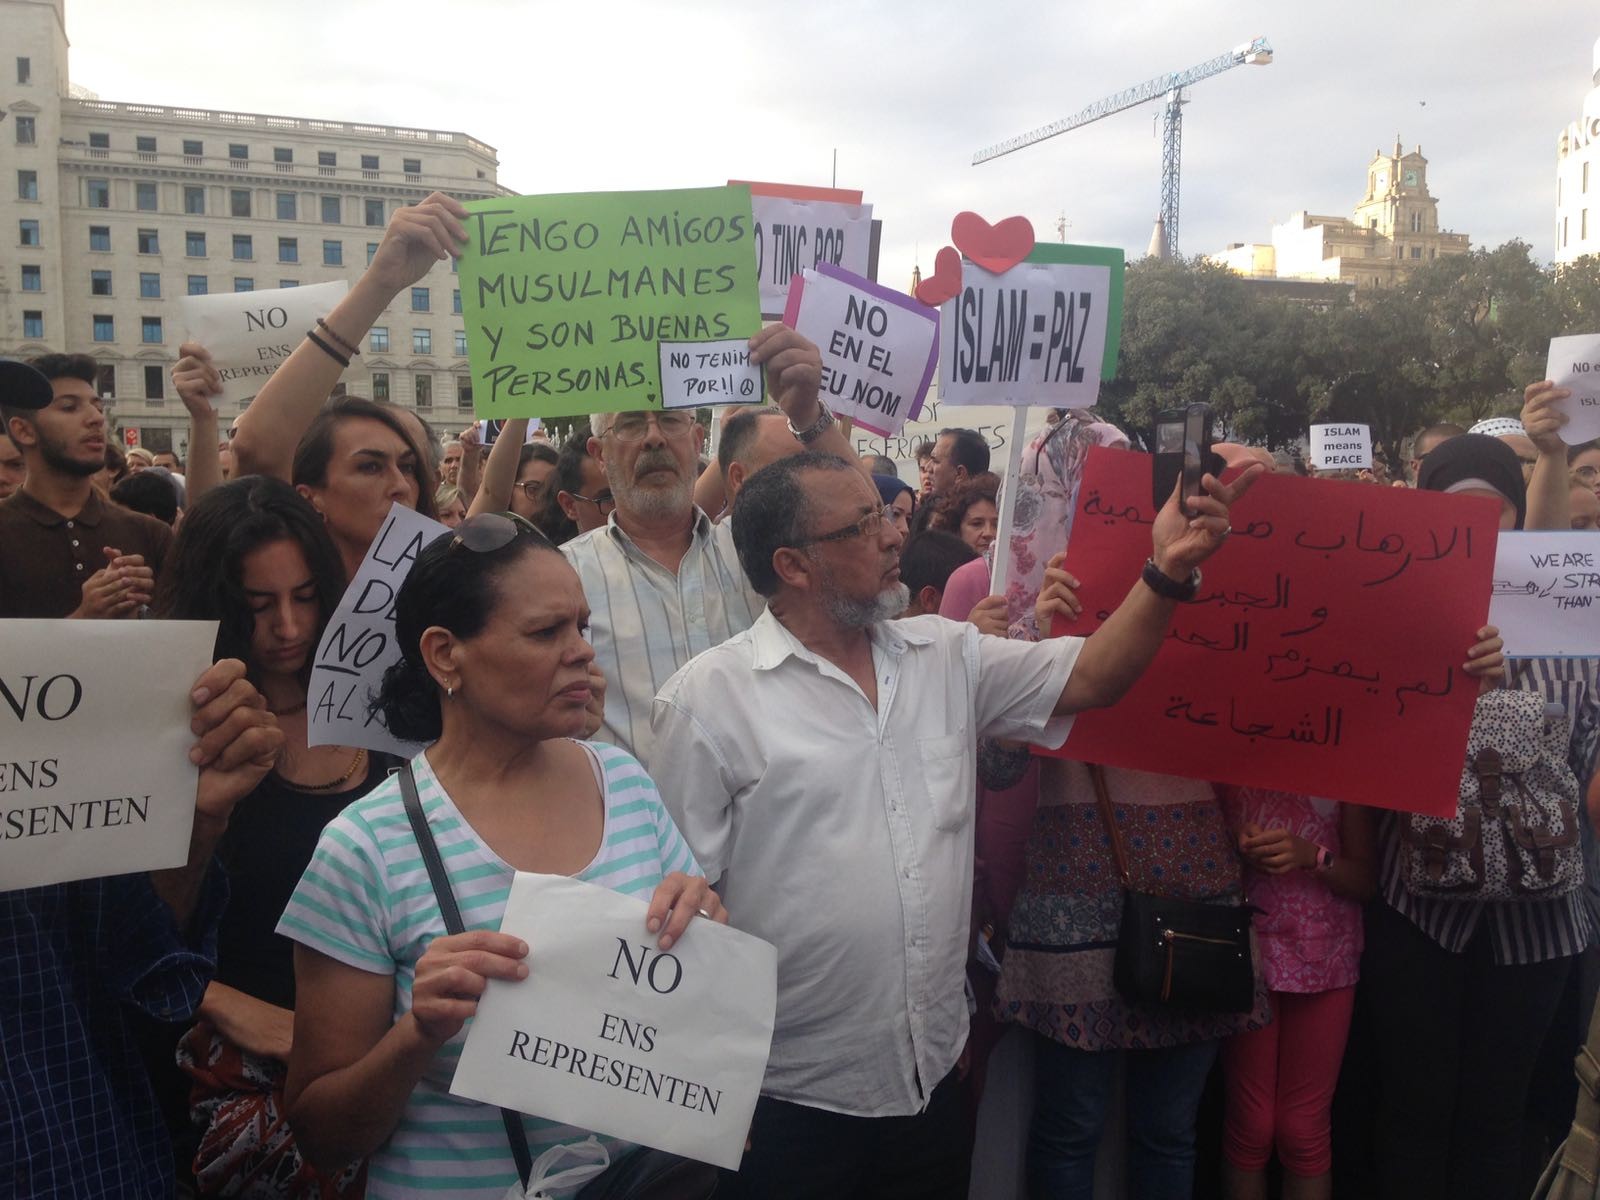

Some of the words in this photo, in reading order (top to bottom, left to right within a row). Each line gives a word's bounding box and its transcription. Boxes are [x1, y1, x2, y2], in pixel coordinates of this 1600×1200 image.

[470, 210, 599, 257] TENGO
[478, 265, 736, 309] MUSULMANES
[243, 307, 288, 332] NO
[844, 294, 888, 338] NO
[257, 344, 292, 360] ENS
[481, 325, 503, 361] Y
[526, 320, 594, 350] SON
[611, 313, 730, 343] BUENAS
[829, 330, 864, 363] EN
[867, 345, 894, 377] EL
[670, 352, 690, 369] NO
[1572, 362, 1590, 373] NO
[482, 361, 652, 402] PERSONAS.
[851, 379, 902, 417] NOM
[1324, 428, 1360, 437] ISLAM
[1325, 455, 1362, 464] PEACE
[373, 516, 424, 571] LA
[1562, 552, 1594, 567] ARE
[1553, 596, 1592, 610] THAN
[321, 622, 387, 668] NO
[0, 674, 83, 722] NO
[607, 936, 683, 994] NO
[598, 1013, 658, 1053] ENS
[507, 1029, 723, 1116] REPRESENTEN
